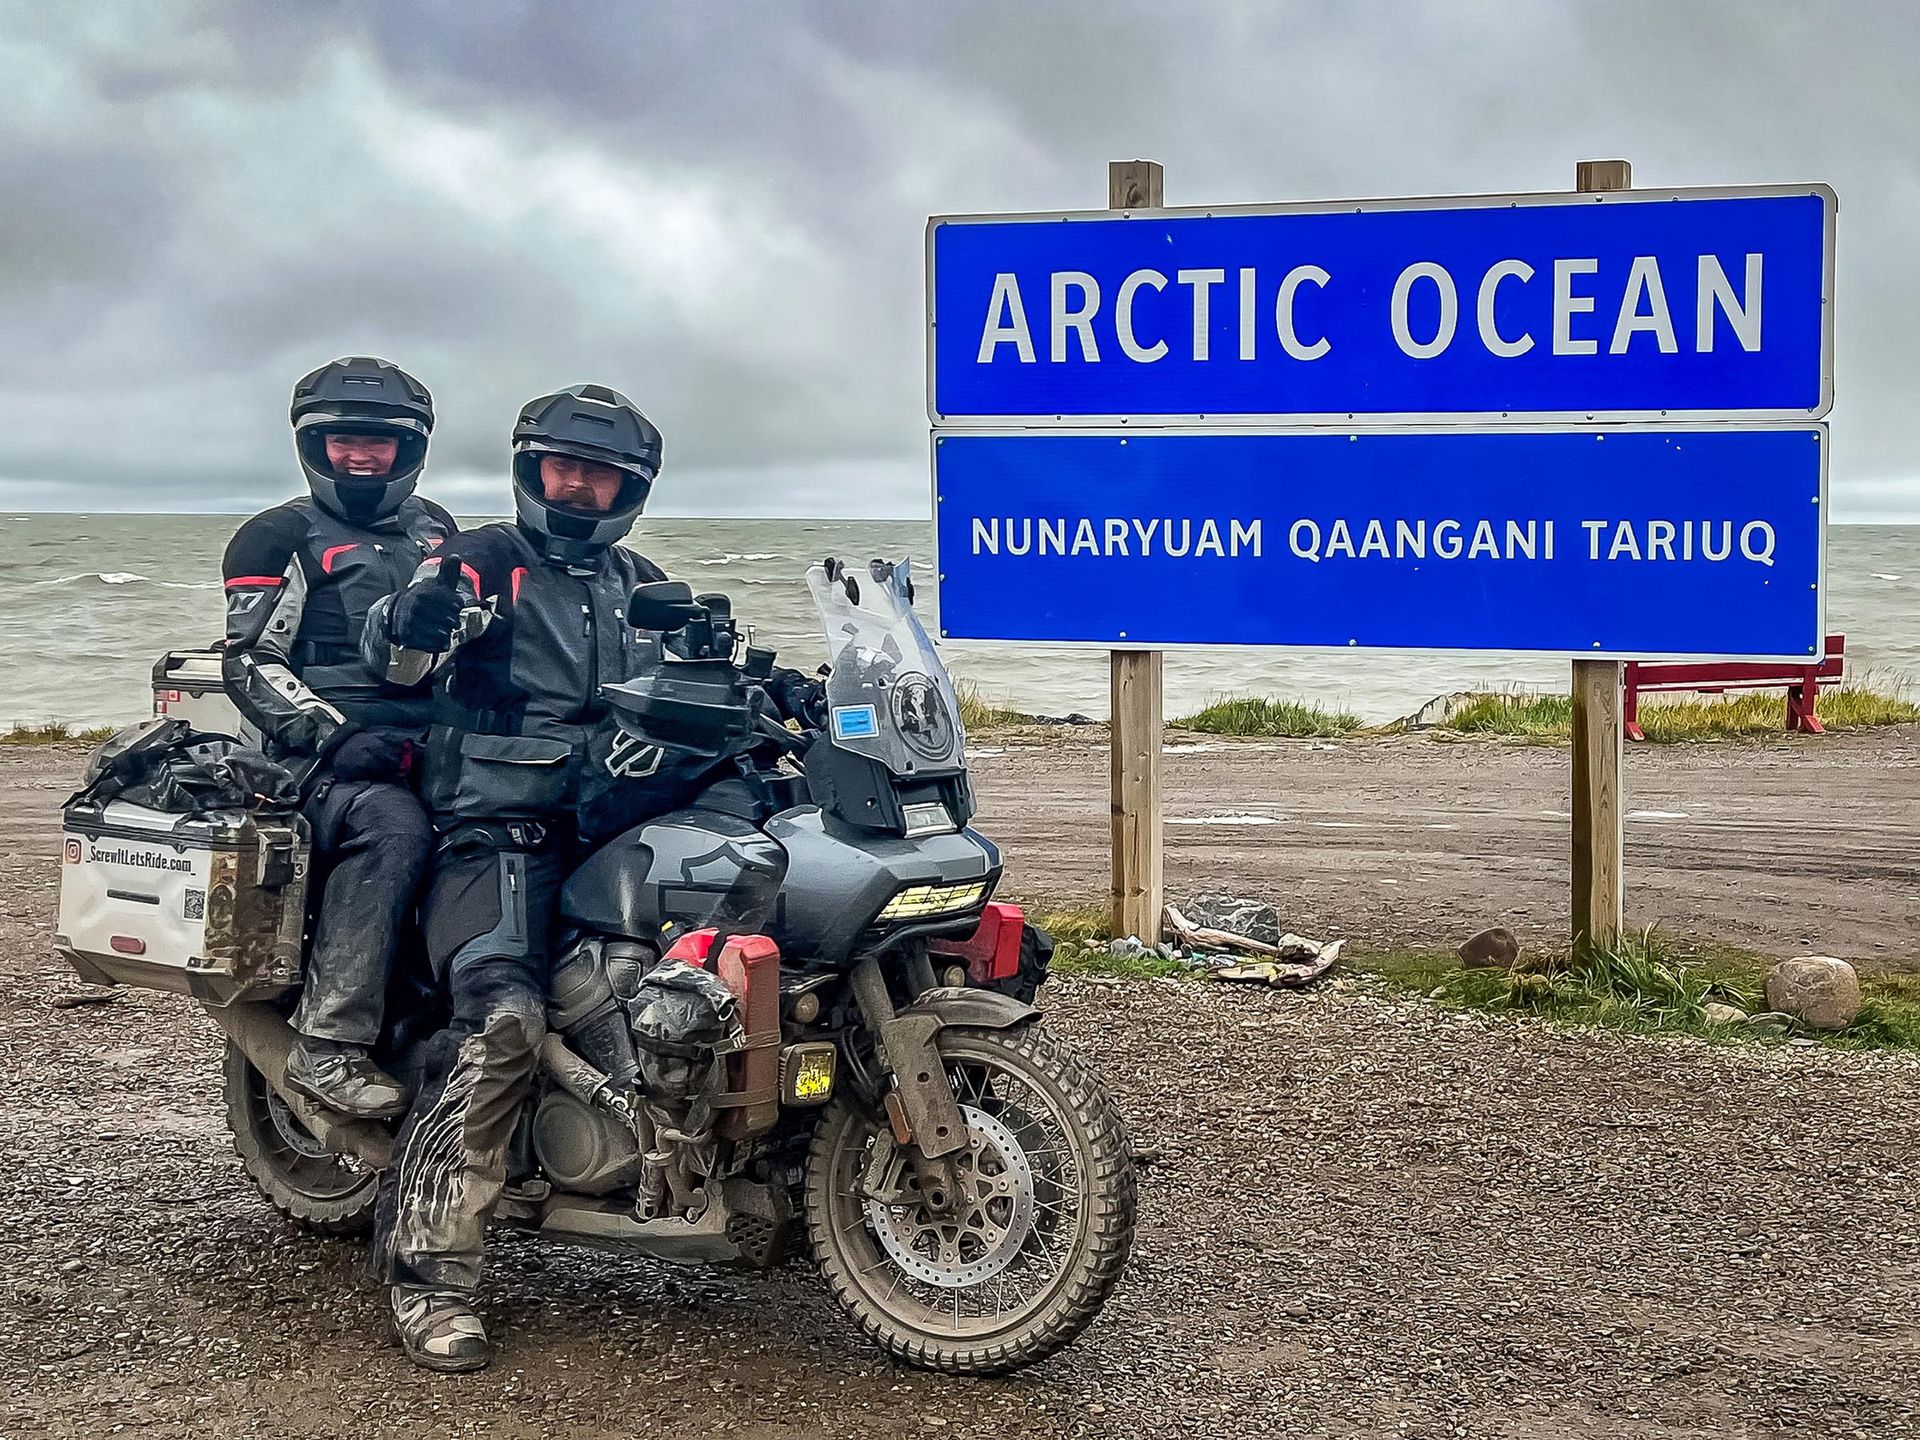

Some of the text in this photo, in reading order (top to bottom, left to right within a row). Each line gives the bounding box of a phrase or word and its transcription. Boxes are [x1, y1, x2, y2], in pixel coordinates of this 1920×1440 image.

[976, 253, 1763, 364] ARCTIC OCEAN
[972, 518, 1776, 567] NUNARYUAM QAANGANI TARIUQ
